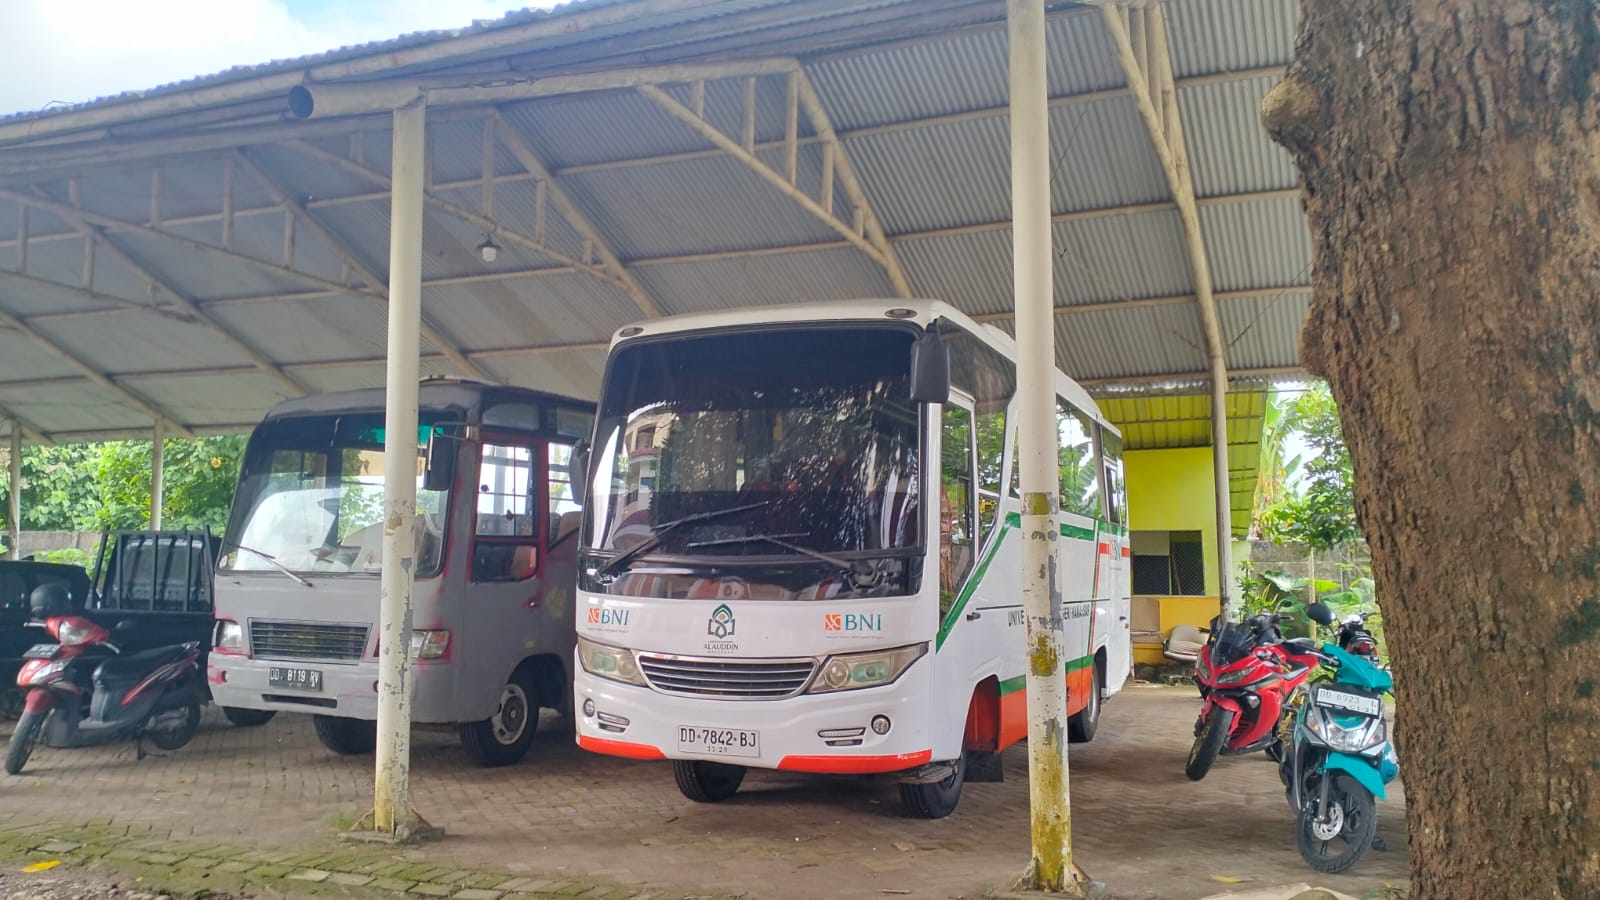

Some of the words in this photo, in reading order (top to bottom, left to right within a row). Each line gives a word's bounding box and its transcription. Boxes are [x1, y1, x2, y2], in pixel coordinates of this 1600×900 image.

[601, 609, 629, 626] BNI
[845, 614, 882, 631] BNI
[270, 668, 279, 680] DD
[288, 669, 306, 682] 8119
[680, 728, 695, 742] DD
[703, 729, 733, 746] 7842
[740, 732, 756, 747] BJ
